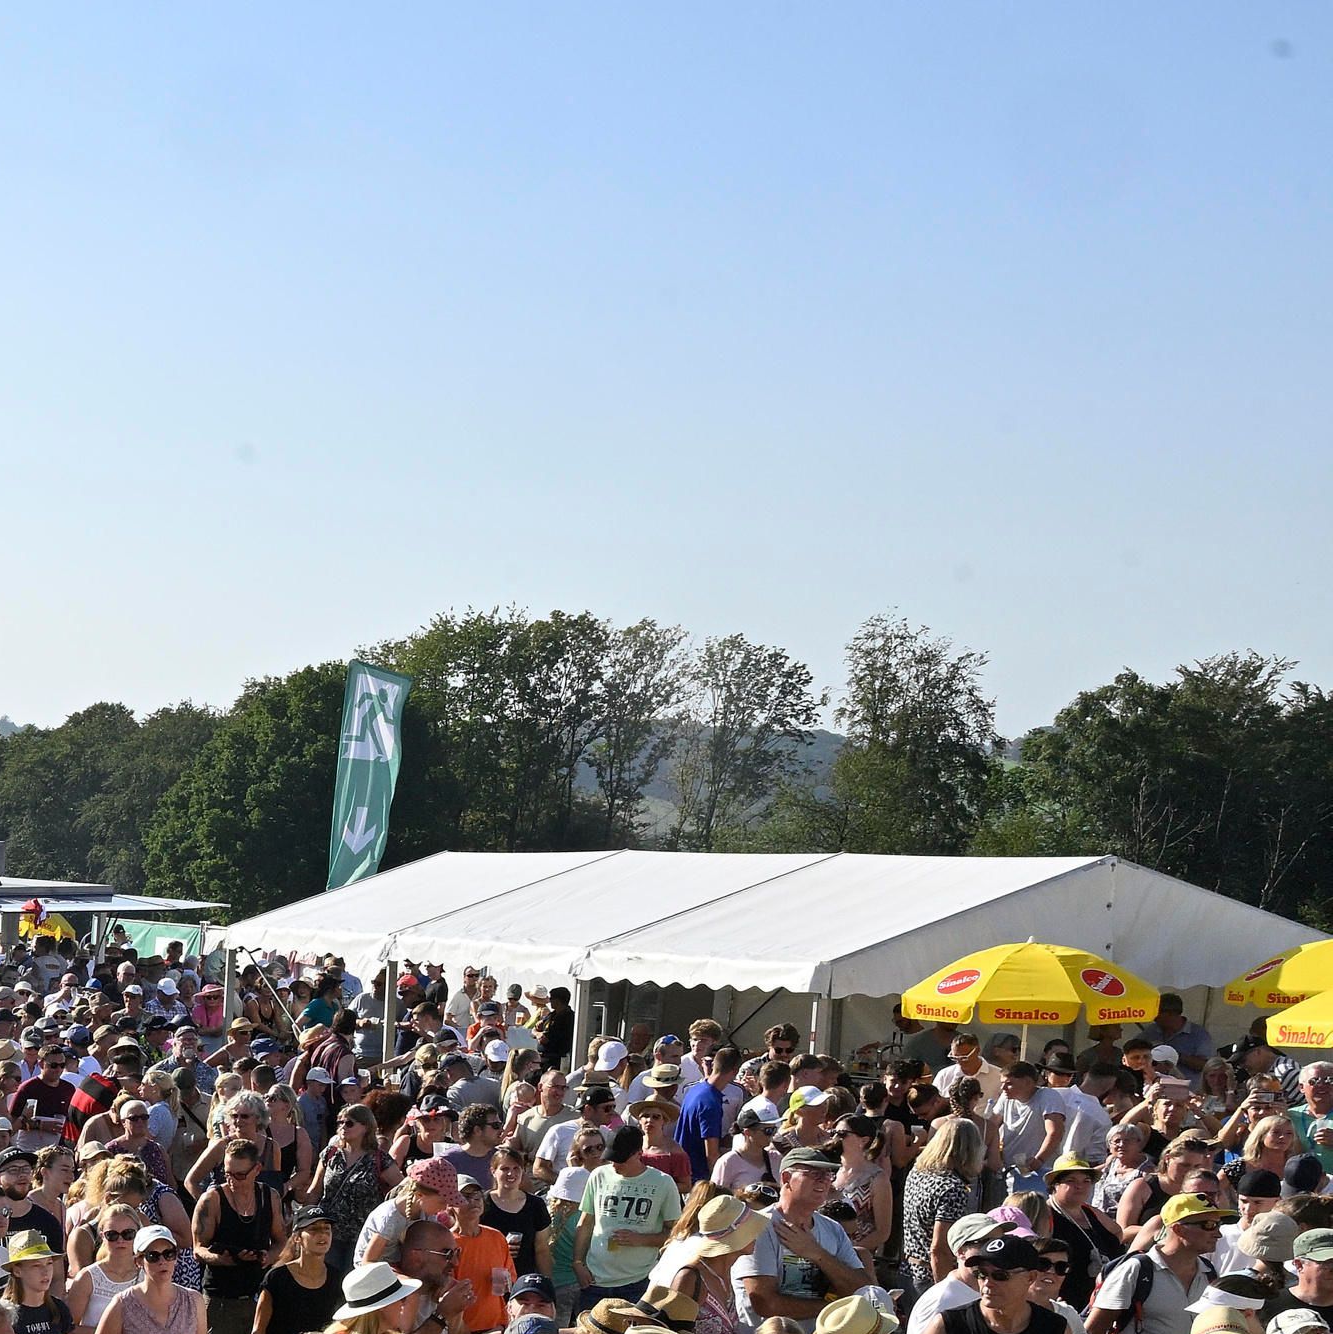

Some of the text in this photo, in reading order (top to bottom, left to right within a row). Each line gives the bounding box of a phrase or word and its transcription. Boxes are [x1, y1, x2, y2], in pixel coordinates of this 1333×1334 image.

[938, 972, 980, 990] Sinalco
[1267, 992, 1306, 1004] Sinal
[916, 1003, 959, 1019] Sinalco
[994, 1008, 1060, 1021] Sinalco
[1098, 1006, 1145, 1020] Sinalco
[1275, 1025, 1325, 1046] Sinalco
